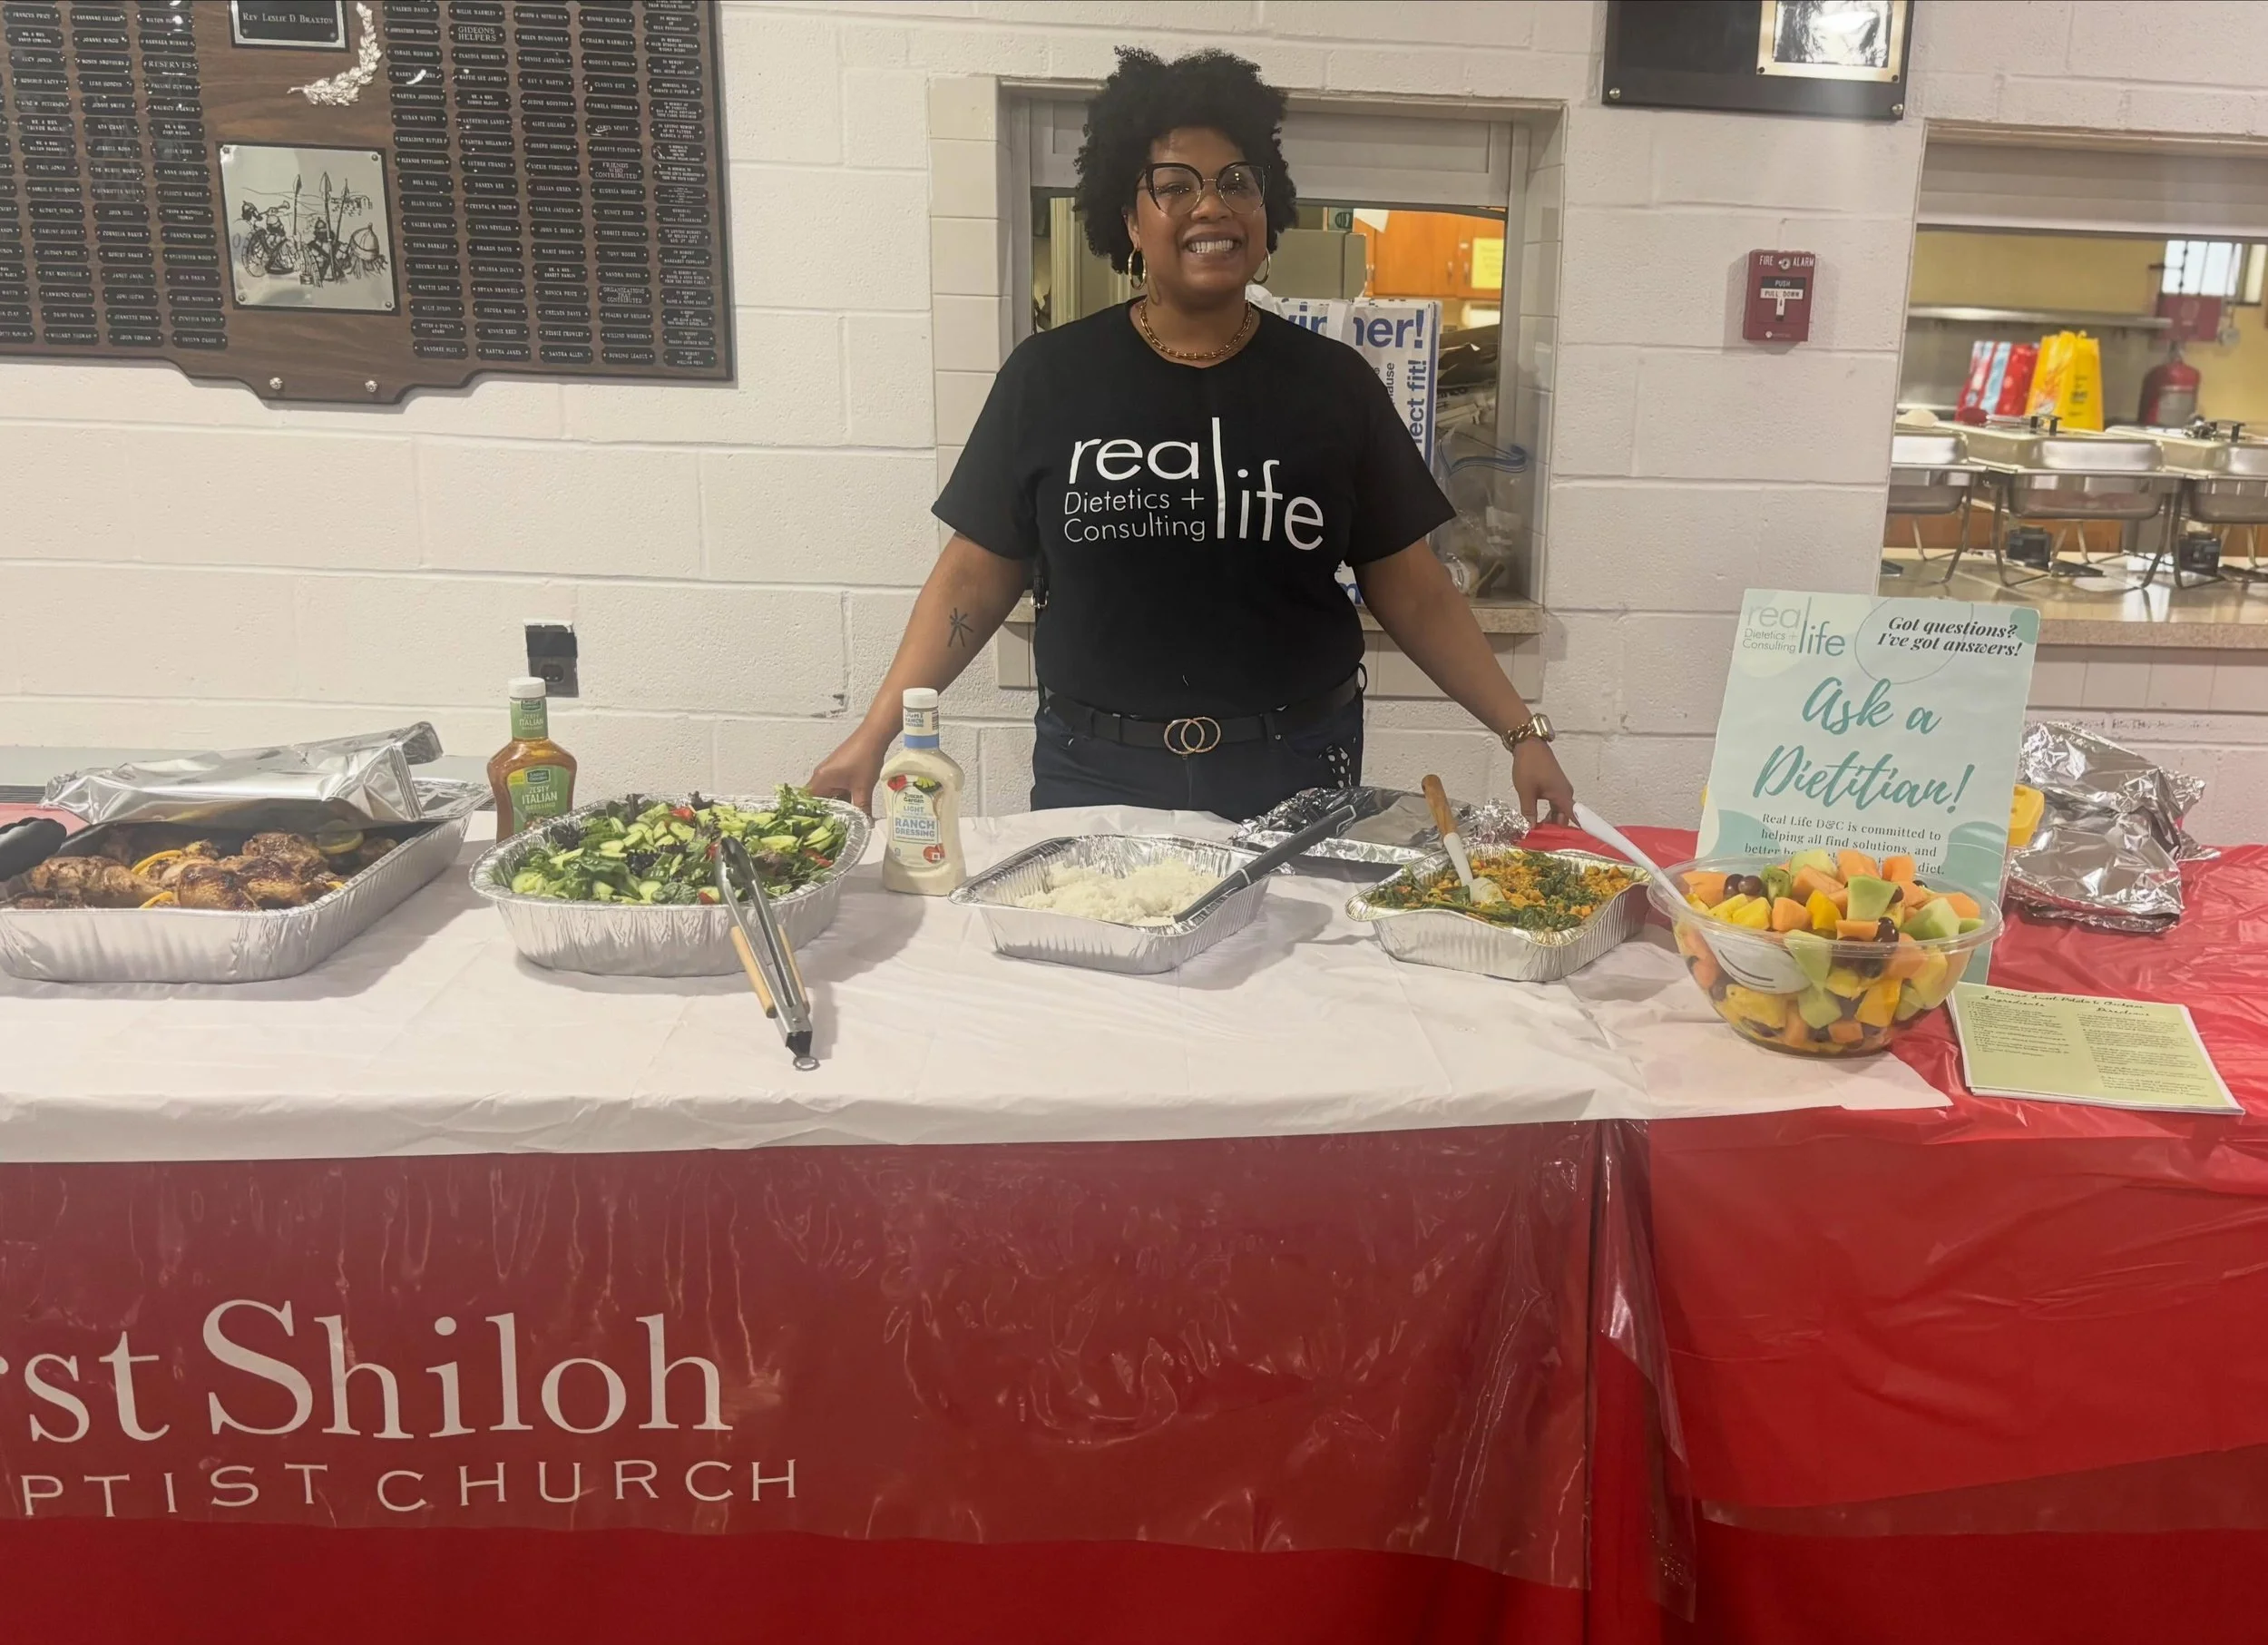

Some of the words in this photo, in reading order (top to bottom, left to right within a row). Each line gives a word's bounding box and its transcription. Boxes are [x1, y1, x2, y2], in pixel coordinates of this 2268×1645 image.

[1759, 256, 1774, 266] FIRE
[1792, 257, 1814, 267] ALARM
[1064, 487, 1170, 515] Dietetics
[1064, 512, 1205, 543] Consulting
[1744, 628, 1786, 640] Dietetics
[1888, 616, 1921, 632] Got
[1923, 620, 2019, 638] questions?
[1742, 638, 1797, 654] Consulting
[1877, 632, 1909, 647] I've
[1912, 634, 1940, 652] got
[1943, 640, 2023, 657] answers!
[1802, 676, 1894, 735] Ask
[1905, 706, 1942, 734] a
[529, 785, 549, 793] ZESTY
[1752, 745, 1975, 814] Dietitian!
[522, 791, 557, 805] ITALIAN
[895, 818, 935, 829] RANCH
[895, 827, 935, 837] DRESSING
[1762, 813, 1786, 825] Real
[1791, 816, 1812, 827] Life
[1816, 818, 1844, 831] D&C
[1847, 822, 1857, 832] is
[1861, 824, 1925, 840] committed
[1930, 830, 1941, 841] to
[1744, 843, 1780, 855] better
[1761, 828, 1804, 844] helping
[1807, 833, 1821, 845] all
[1825, 835, 1849, 848] find
[1852, 839, 1910, 855] solutions,
[1915, 846, 1937, 858] and
[1918, 862, 1945, 875] diet.
[201, 1298, 734, 1439] Shiloh
[376, 1458, 798, 1513] CHURCH
